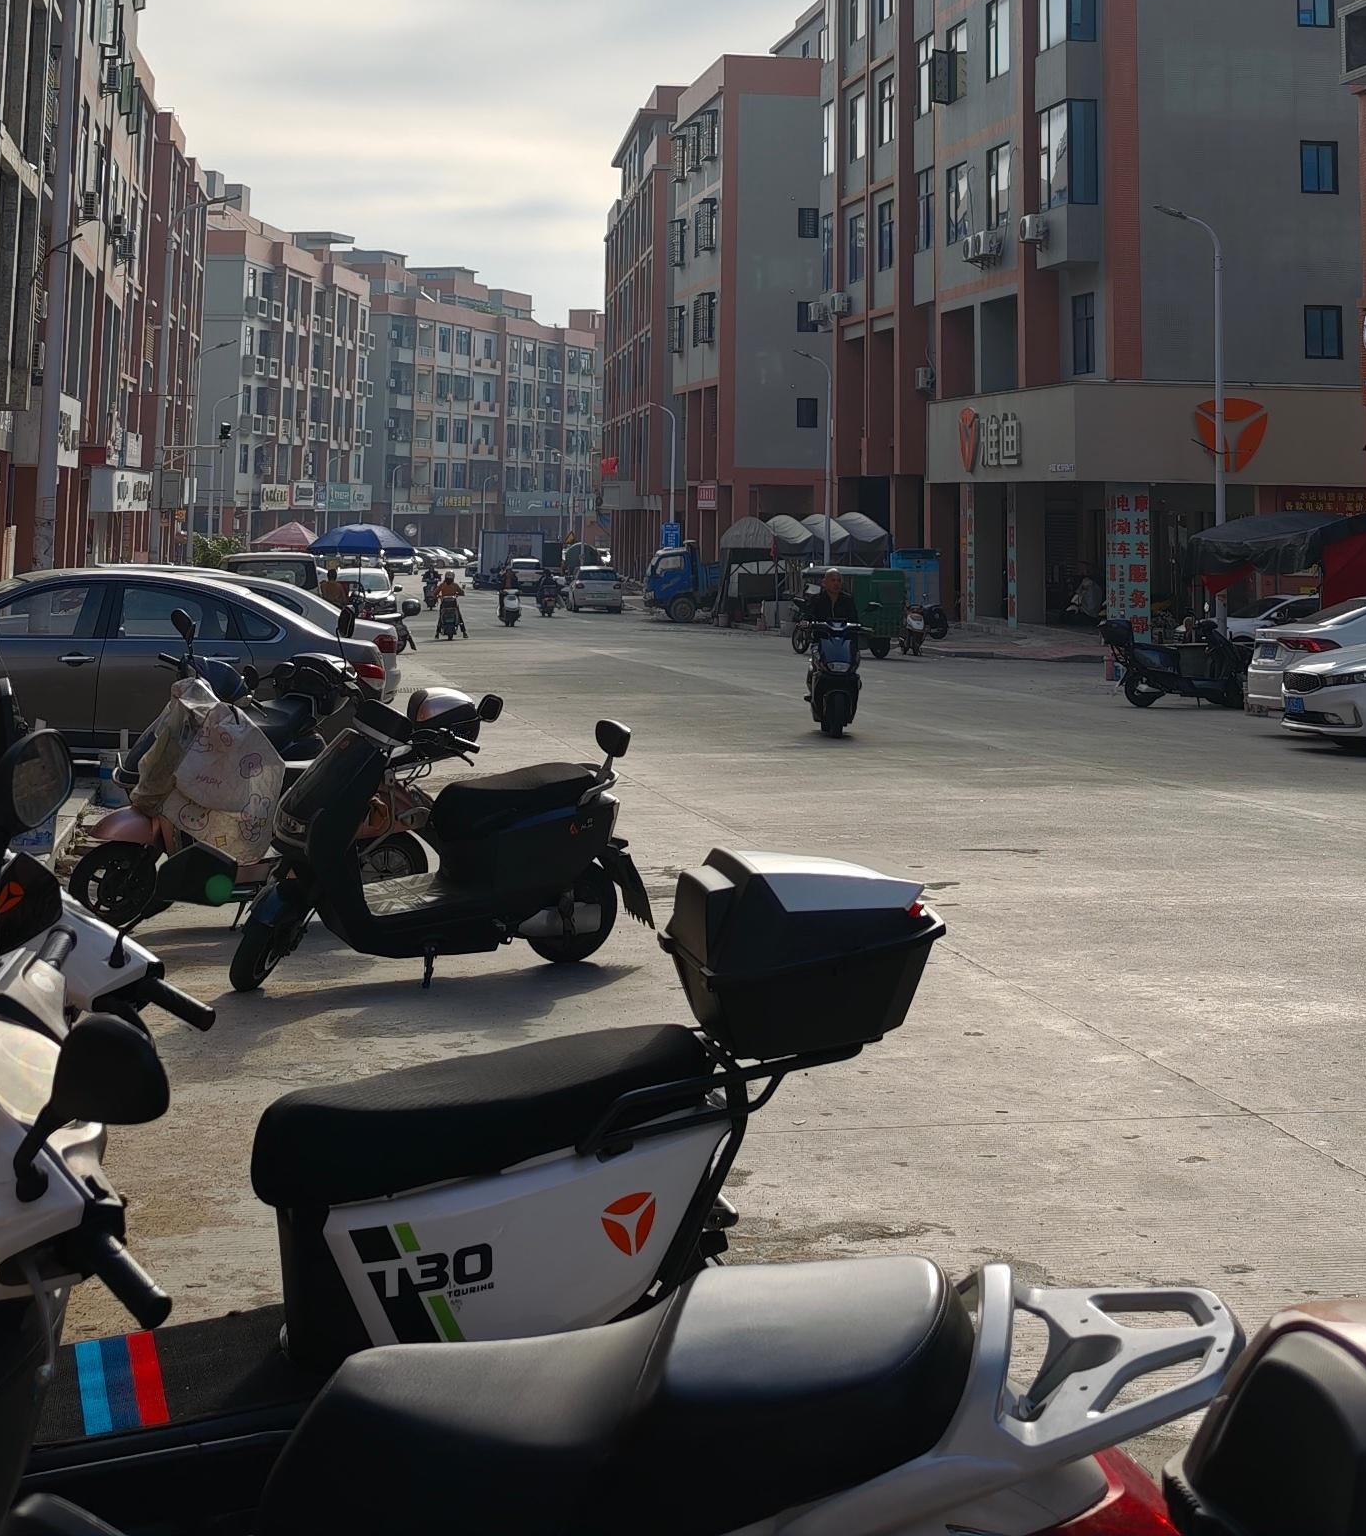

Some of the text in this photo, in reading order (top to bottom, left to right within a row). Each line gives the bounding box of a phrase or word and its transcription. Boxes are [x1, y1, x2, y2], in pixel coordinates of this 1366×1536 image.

[979, 413, 1021, 465] 雅迪
[1116, 495, 1131, 558] 电动车
[366, 1243, 493, 1298] T30
[446, 1282, 495, 1298] TOURING
